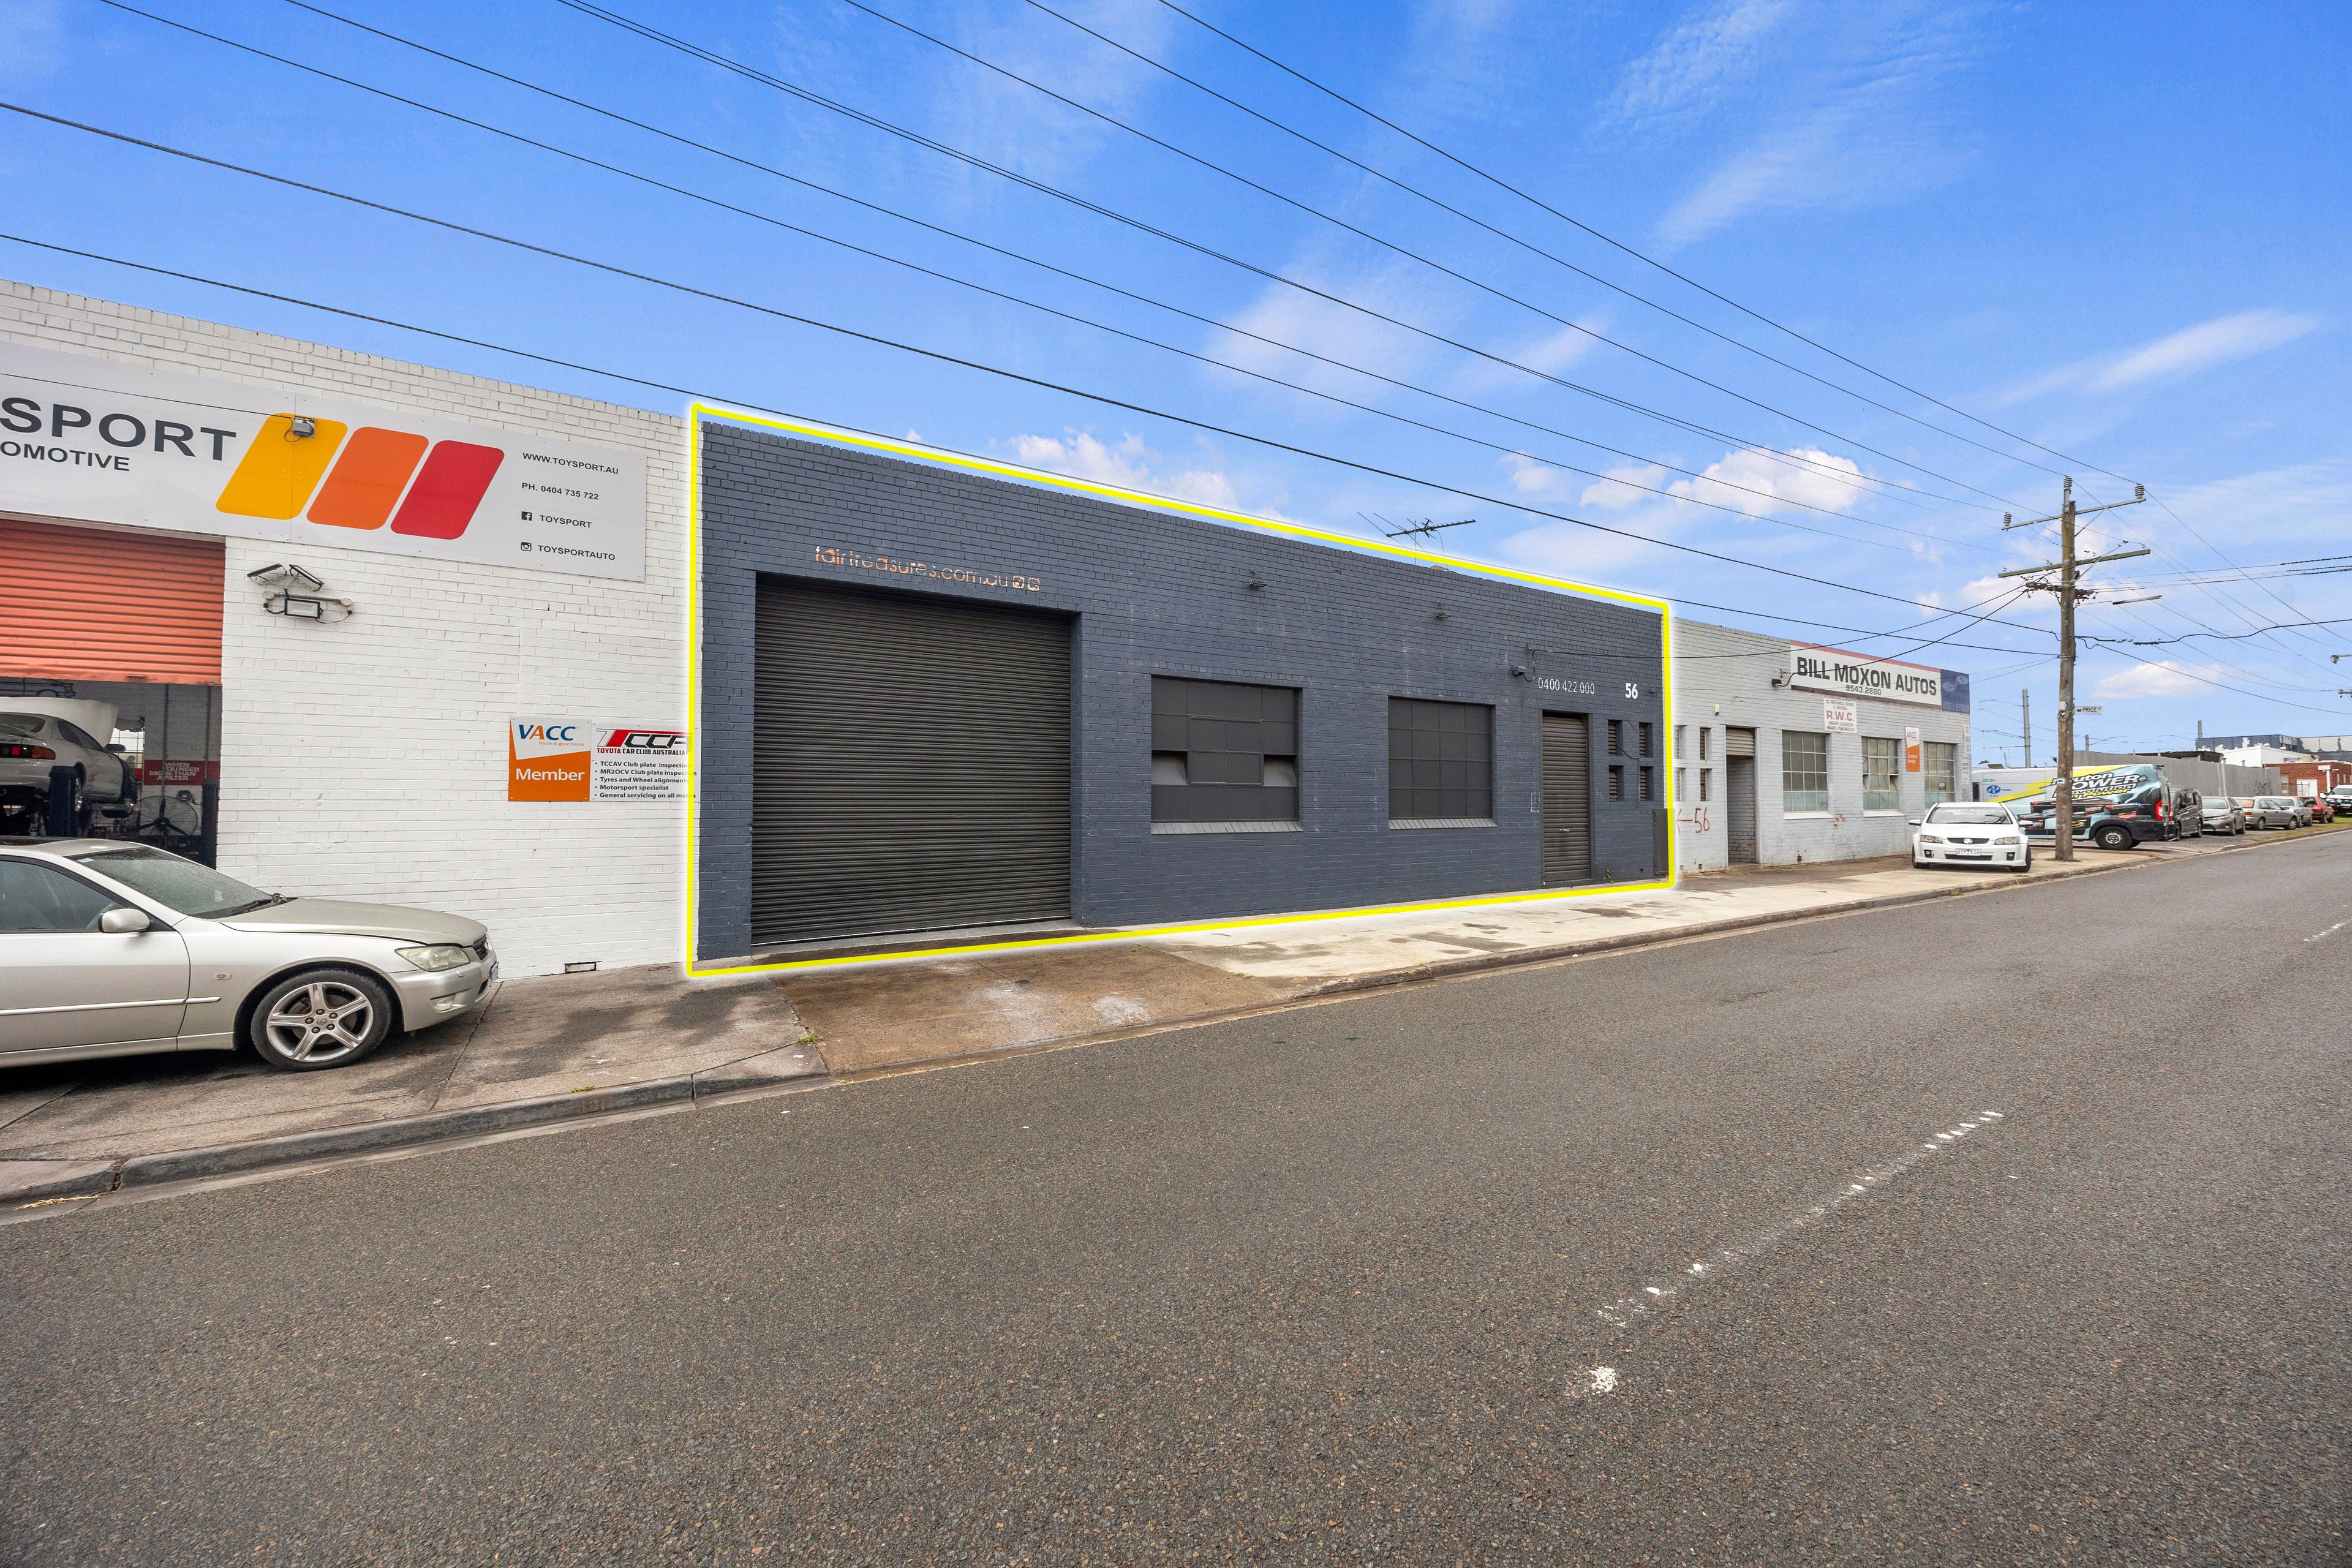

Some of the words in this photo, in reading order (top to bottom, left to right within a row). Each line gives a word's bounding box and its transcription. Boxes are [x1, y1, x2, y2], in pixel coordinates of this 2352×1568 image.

[0, 396, 236, 461] SPORT
[0, 440, 130, 472] OMOTIVE
[522, 452, 619, 475] WWW.TOYSPORT.AU
[522, 482, 538, 491] PH.
[541, 484, 562, 495] 0404
[565, 488, 581, 497] 735
[583, 491, 599, 500] 722
[539, 514, 592, 528] TOYSPORT
[538, 545, 616, 560] TOYSPORTAUTO
[1796, 656, 1830, 681] BILL
[1834, 663, 1891, 690] MOXON
[1895, 673, 1937, 696] AUTOS
[1538, 677, 1560, 692] 0400
[1562, 680, 1578, 693] 422
[1580, 682, 1595, 695] 000
[1625, 682, 1638, 699] 56
[1845, 684, 1882, 696] 9543.2880
[1826, 710, 1855, 722] R.W.C.
[518, 724, 576, 741] VACC
[515, 768, 586, 781] Member
[2072, 774, 2141, 791] OWER
[2082, 788, 2131, 798] Power
[1694, 807, 1711, 834] 56
